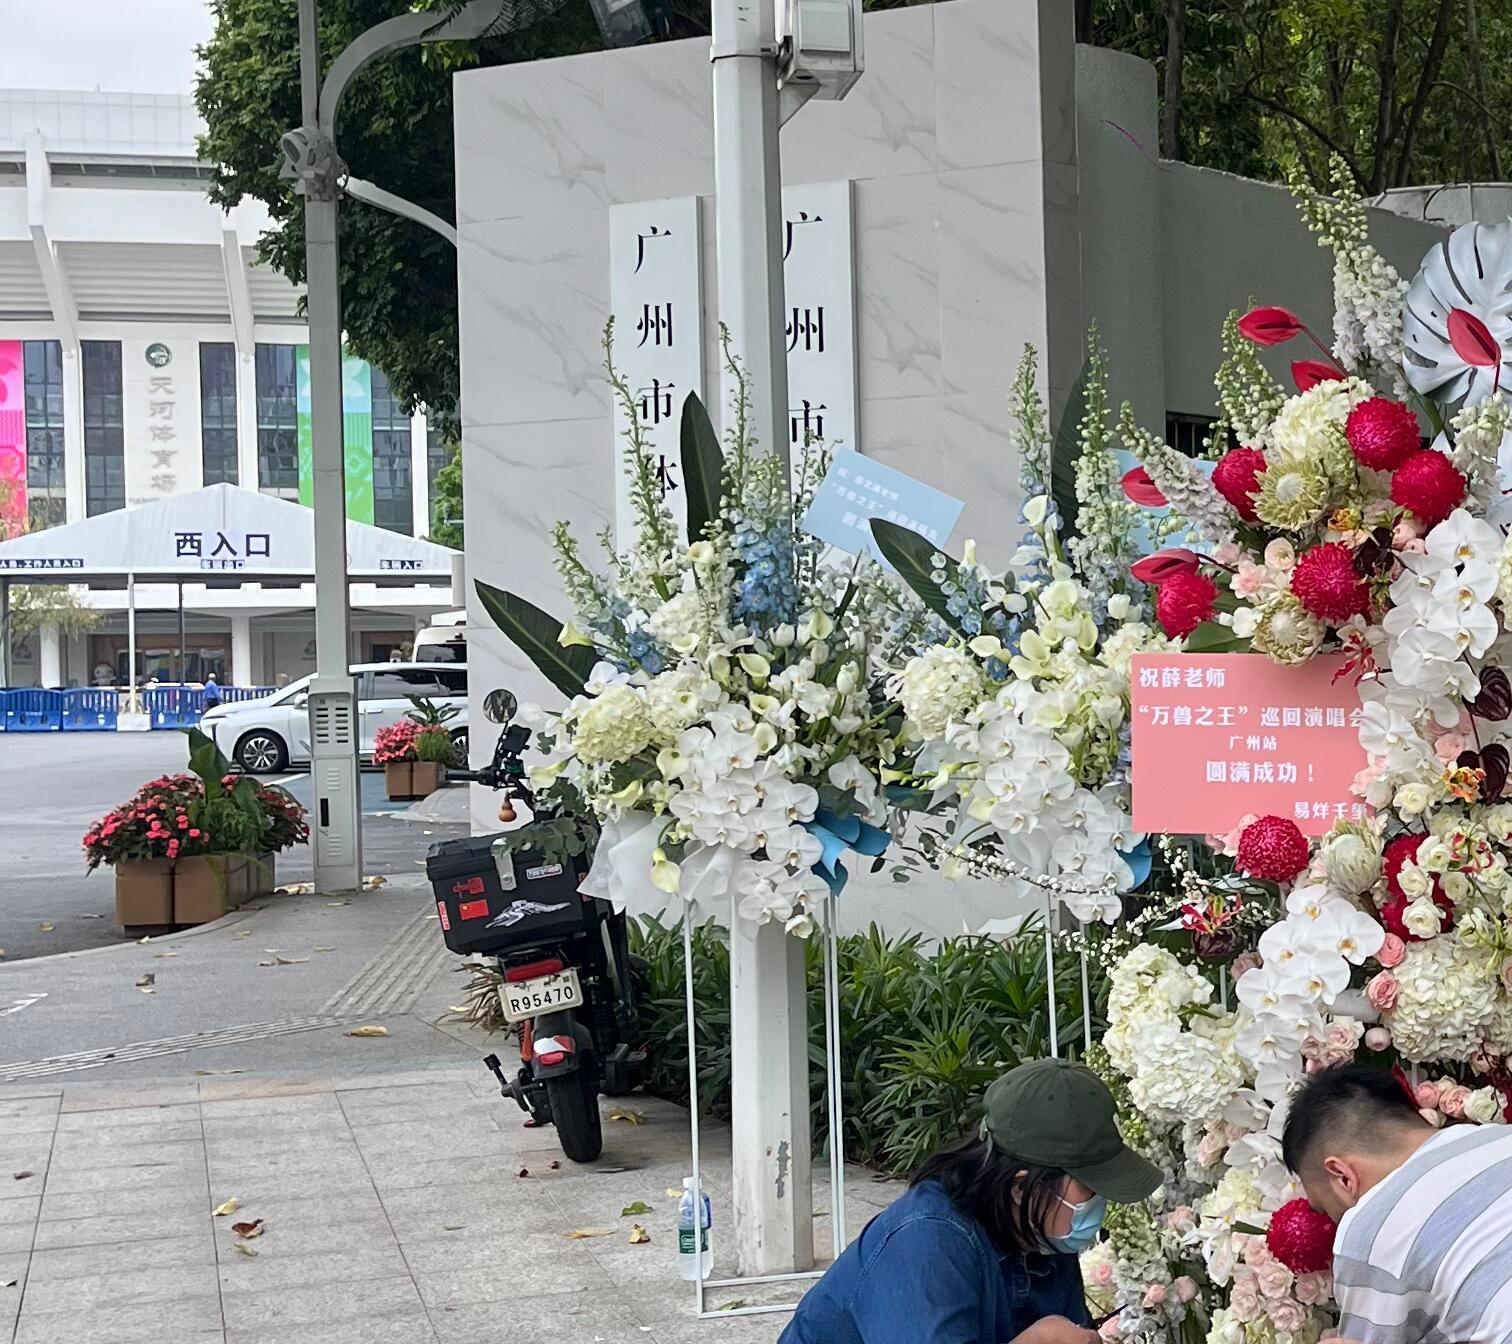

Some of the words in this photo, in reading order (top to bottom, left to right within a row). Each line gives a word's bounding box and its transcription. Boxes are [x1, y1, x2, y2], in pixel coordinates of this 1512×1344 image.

[148, 375, 178, 493] 天河体育场
[174, 532, 271, 558] 西入口
[1139, 667, 1226, 688] 祝薛老师
[1138, 705, 1248, 727] “万兽之王”
[1260, 706, 1364, 728] 巡回演唱会
[1228, 735, 1278, 752] 广州站
[1205, 760, 1315, 784] 圆满成功！
[510, 986, 573, 1013] R95470
